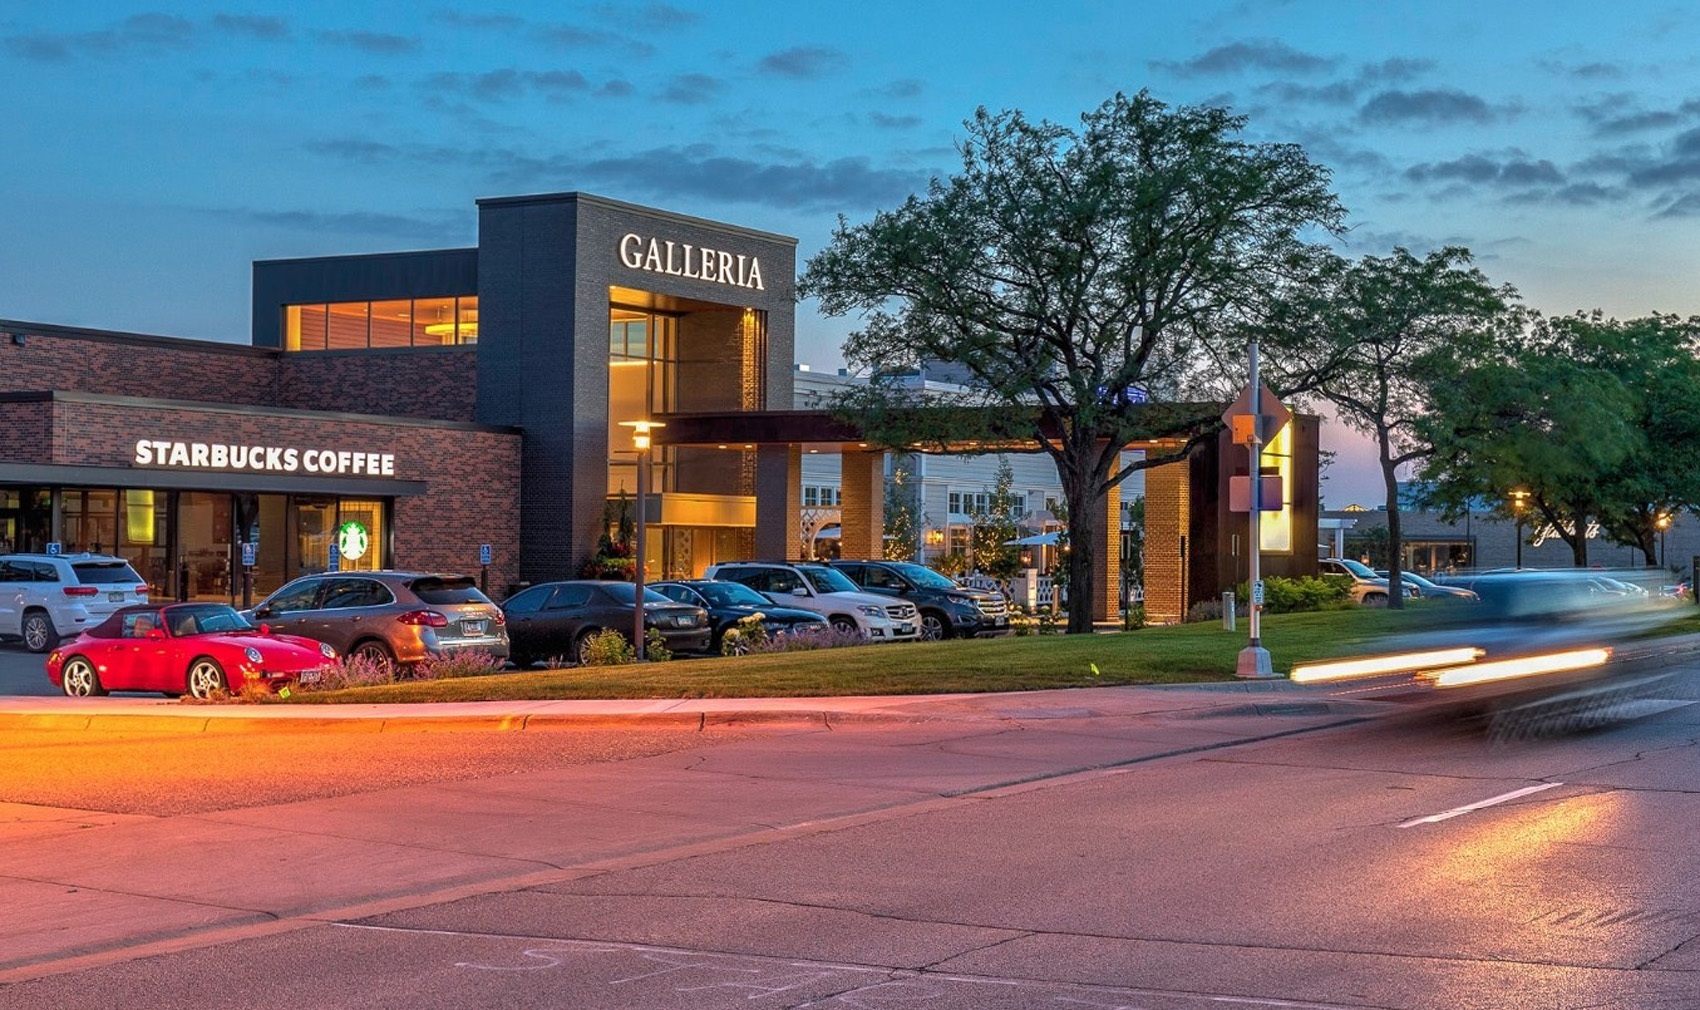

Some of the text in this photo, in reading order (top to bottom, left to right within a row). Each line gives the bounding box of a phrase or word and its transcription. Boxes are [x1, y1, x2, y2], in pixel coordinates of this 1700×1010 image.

[619, 233, 765, 291] GALLERIA
[135, 439, 395, 476] STARBUCKS COFFEE
